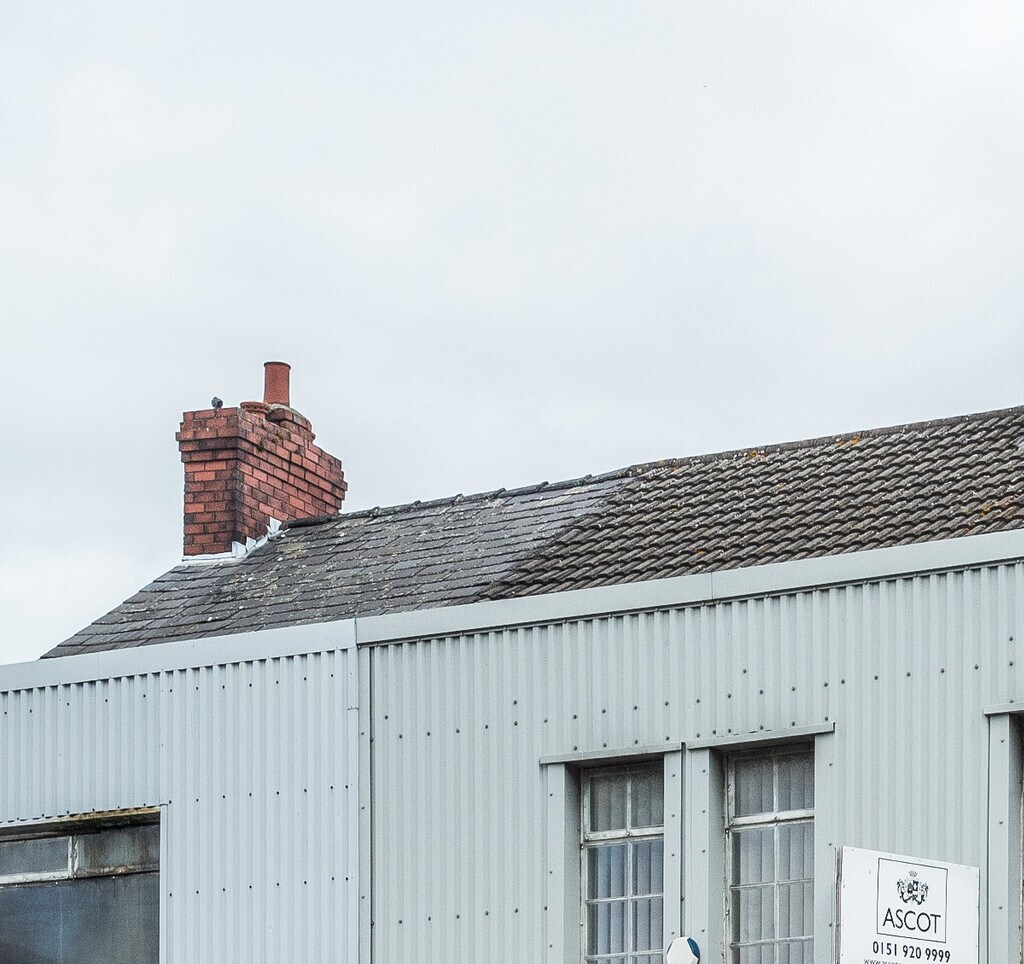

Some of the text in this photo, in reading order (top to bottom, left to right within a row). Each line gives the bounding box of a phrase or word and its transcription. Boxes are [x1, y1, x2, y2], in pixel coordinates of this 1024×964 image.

[882, 907, 942, 934] ASCOT
[872, 941, 951, 963] 0151 920 9999
